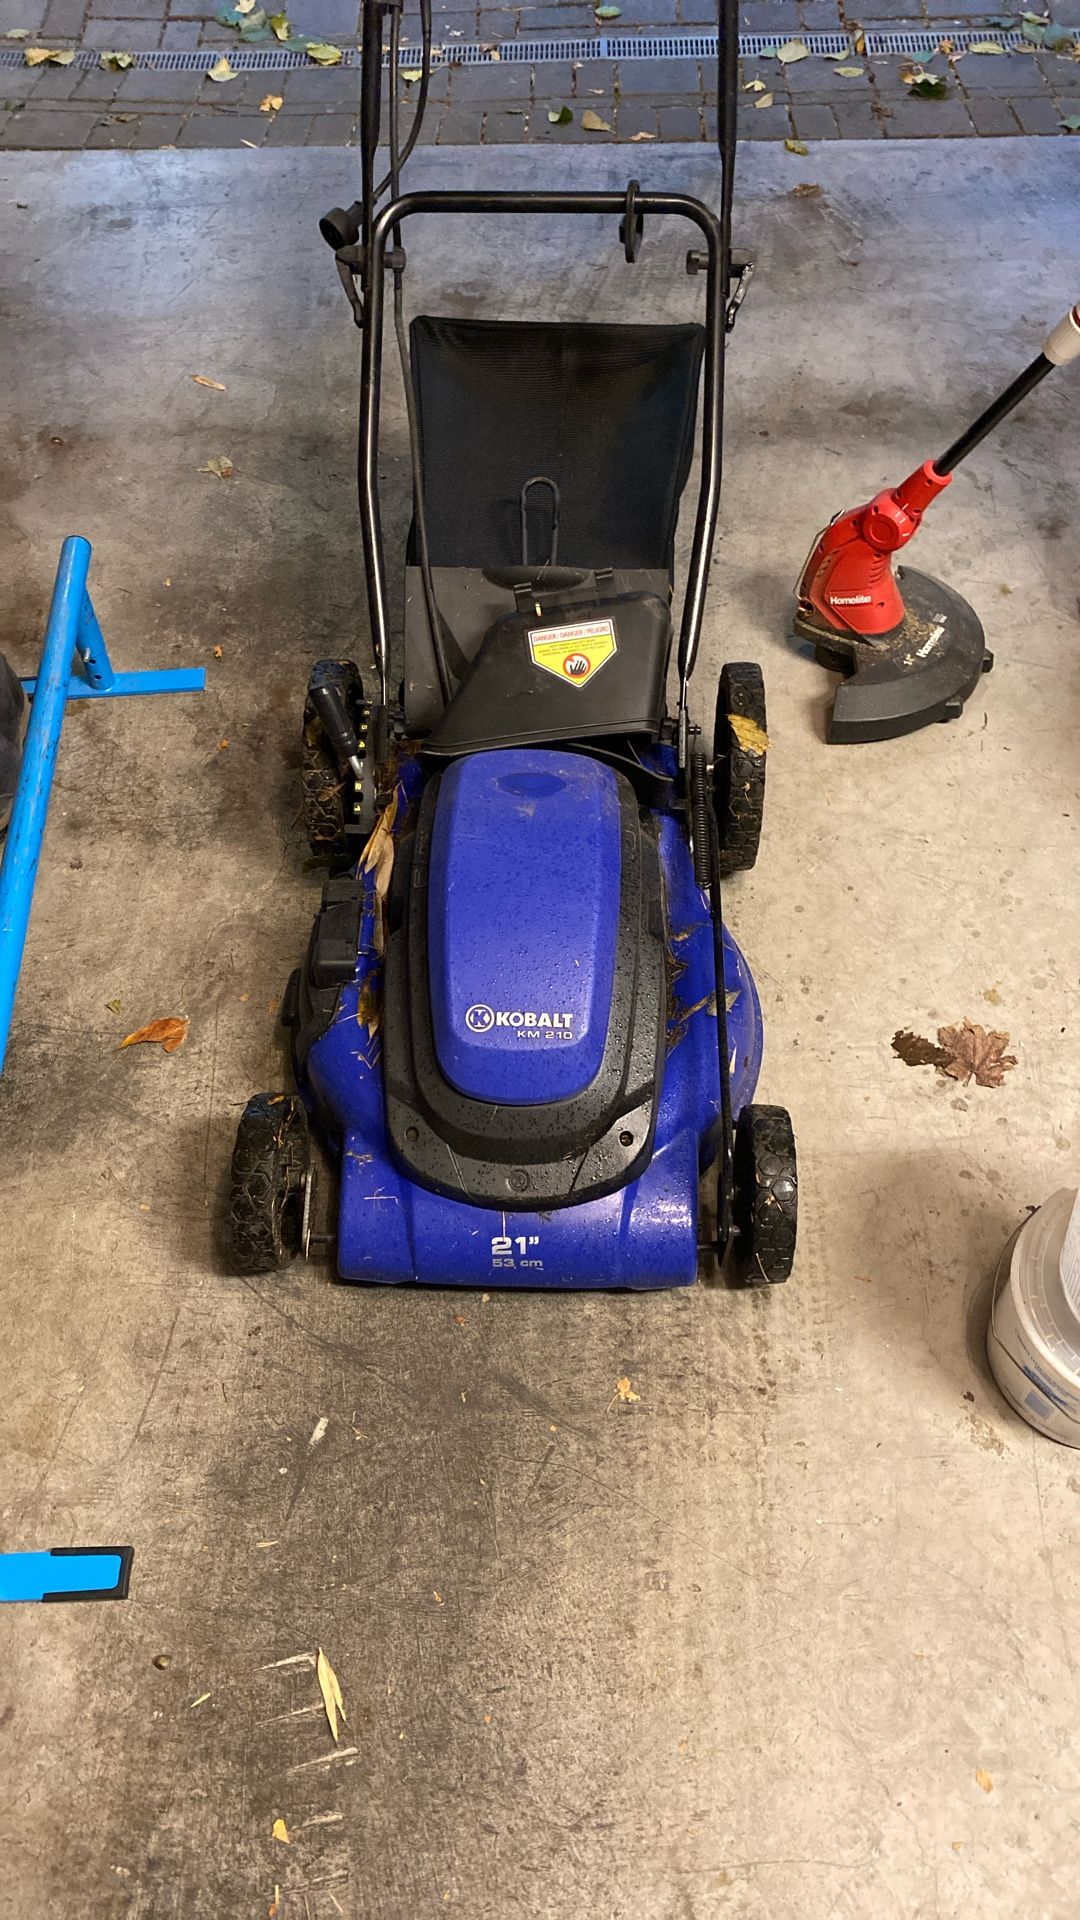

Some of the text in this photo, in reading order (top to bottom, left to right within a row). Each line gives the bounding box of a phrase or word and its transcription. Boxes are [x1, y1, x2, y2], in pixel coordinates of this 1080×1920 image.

[830, 596, 872, 605] Homelite
[496, 1011, 574, 1028] KOBALT
[517, 1030, 573, 1039] KM 210
[492, 1258, 515, 1268] 53
